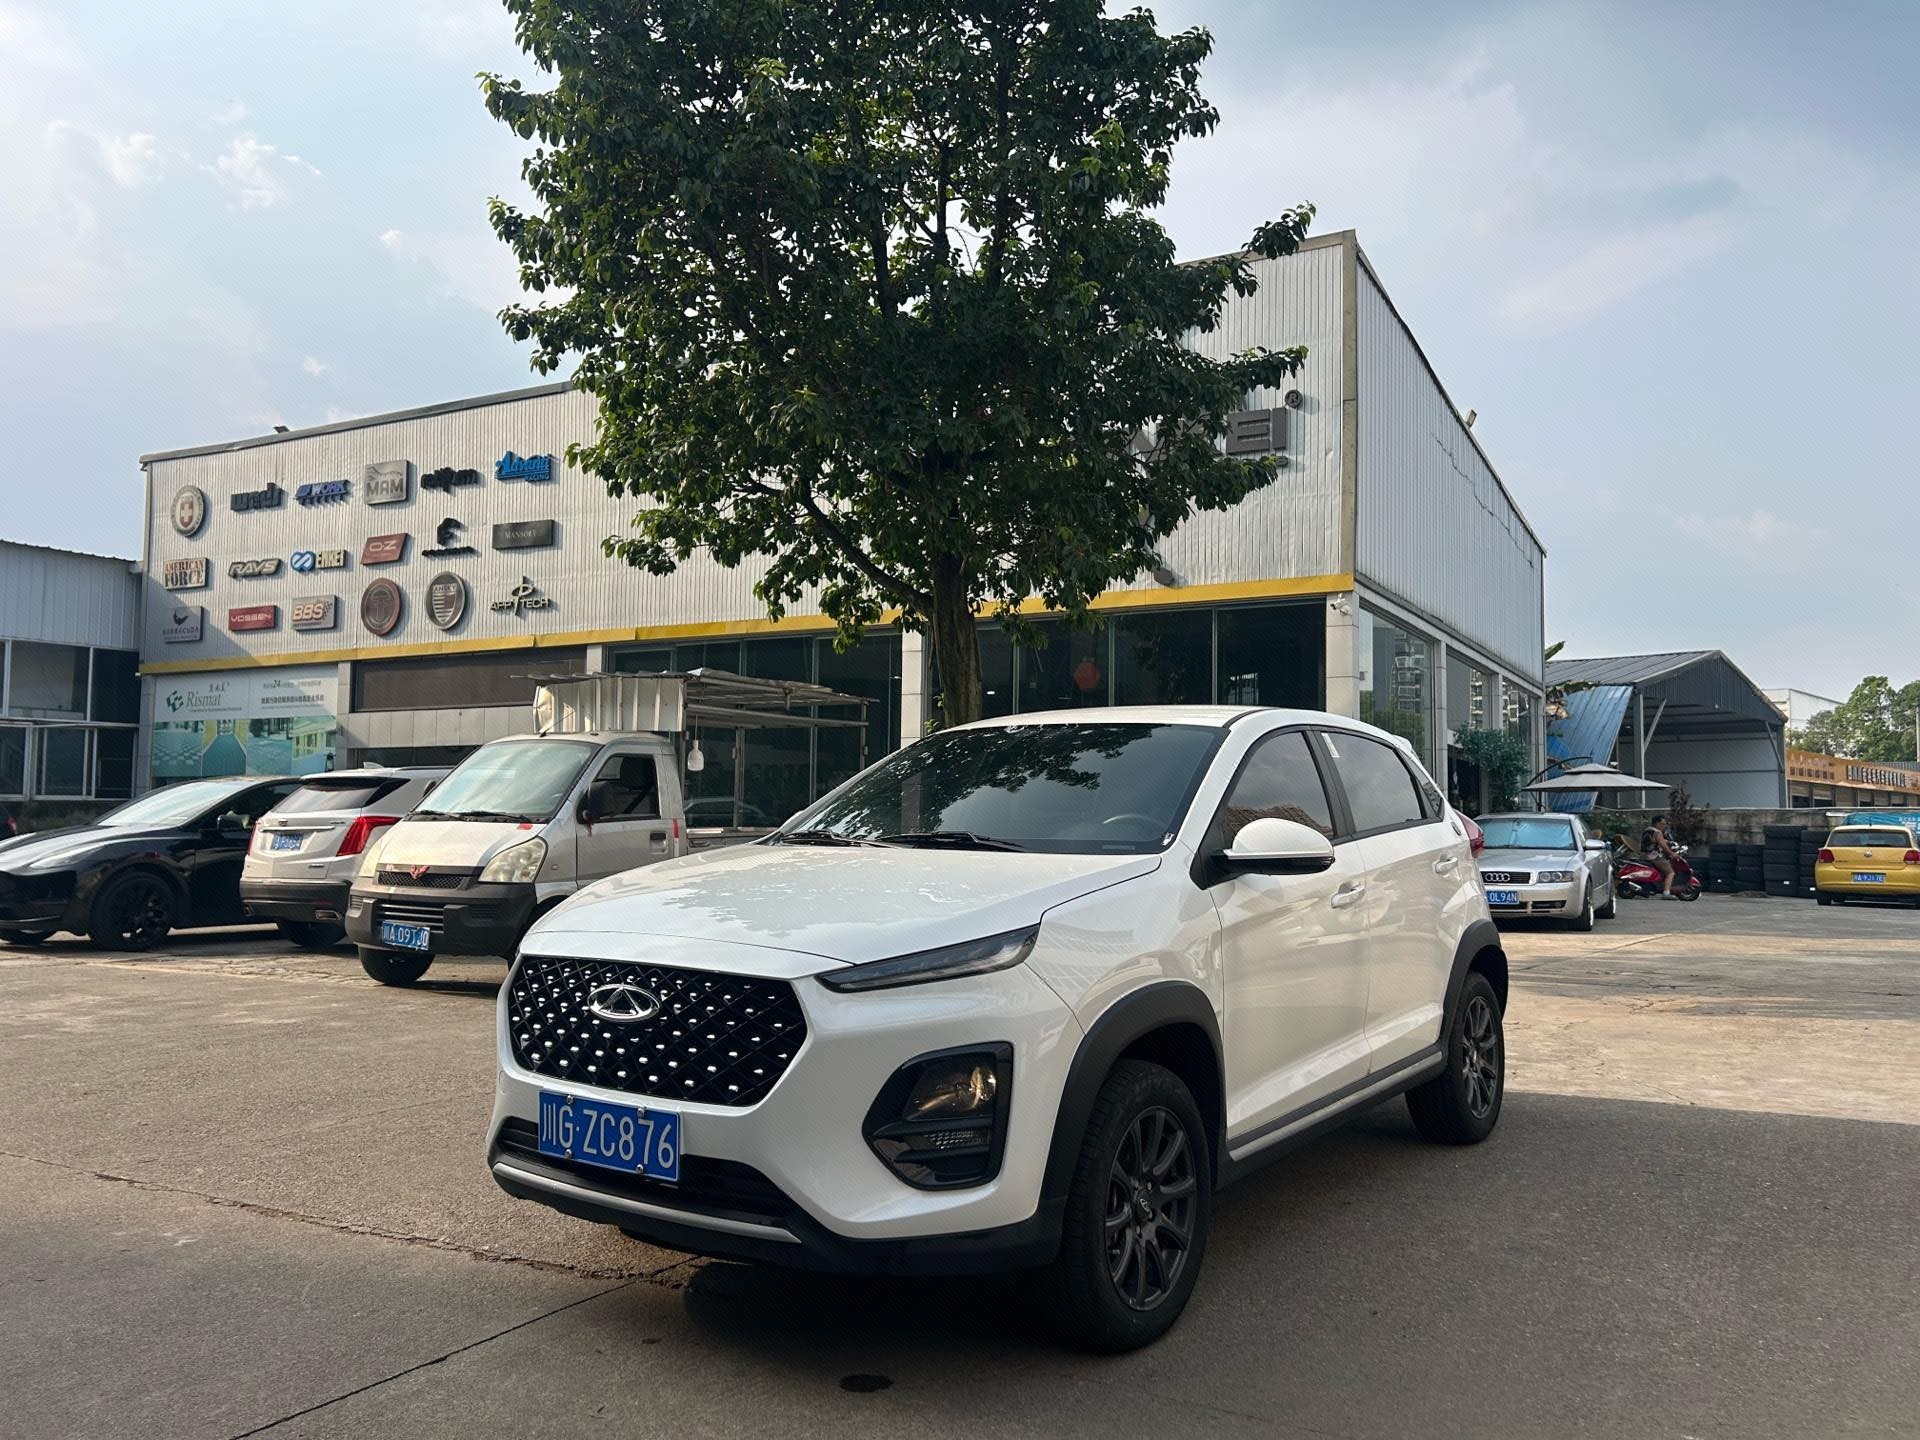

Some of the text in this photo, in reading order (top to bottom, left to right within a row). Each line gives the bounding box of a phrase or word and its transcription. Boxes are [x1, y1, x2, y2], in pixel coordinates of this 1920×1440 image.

[311, 481, 345, 496] WORK
[366, 478, 404, 496] MAM
[164, 560, 204, 575] AMERICAN
[229, 560, 279, 576] RAYS
[164, 571, 204, 588] FORCE
[292, 603, 324, 621] BBS
[186, 692, 221, 707] Rismat
